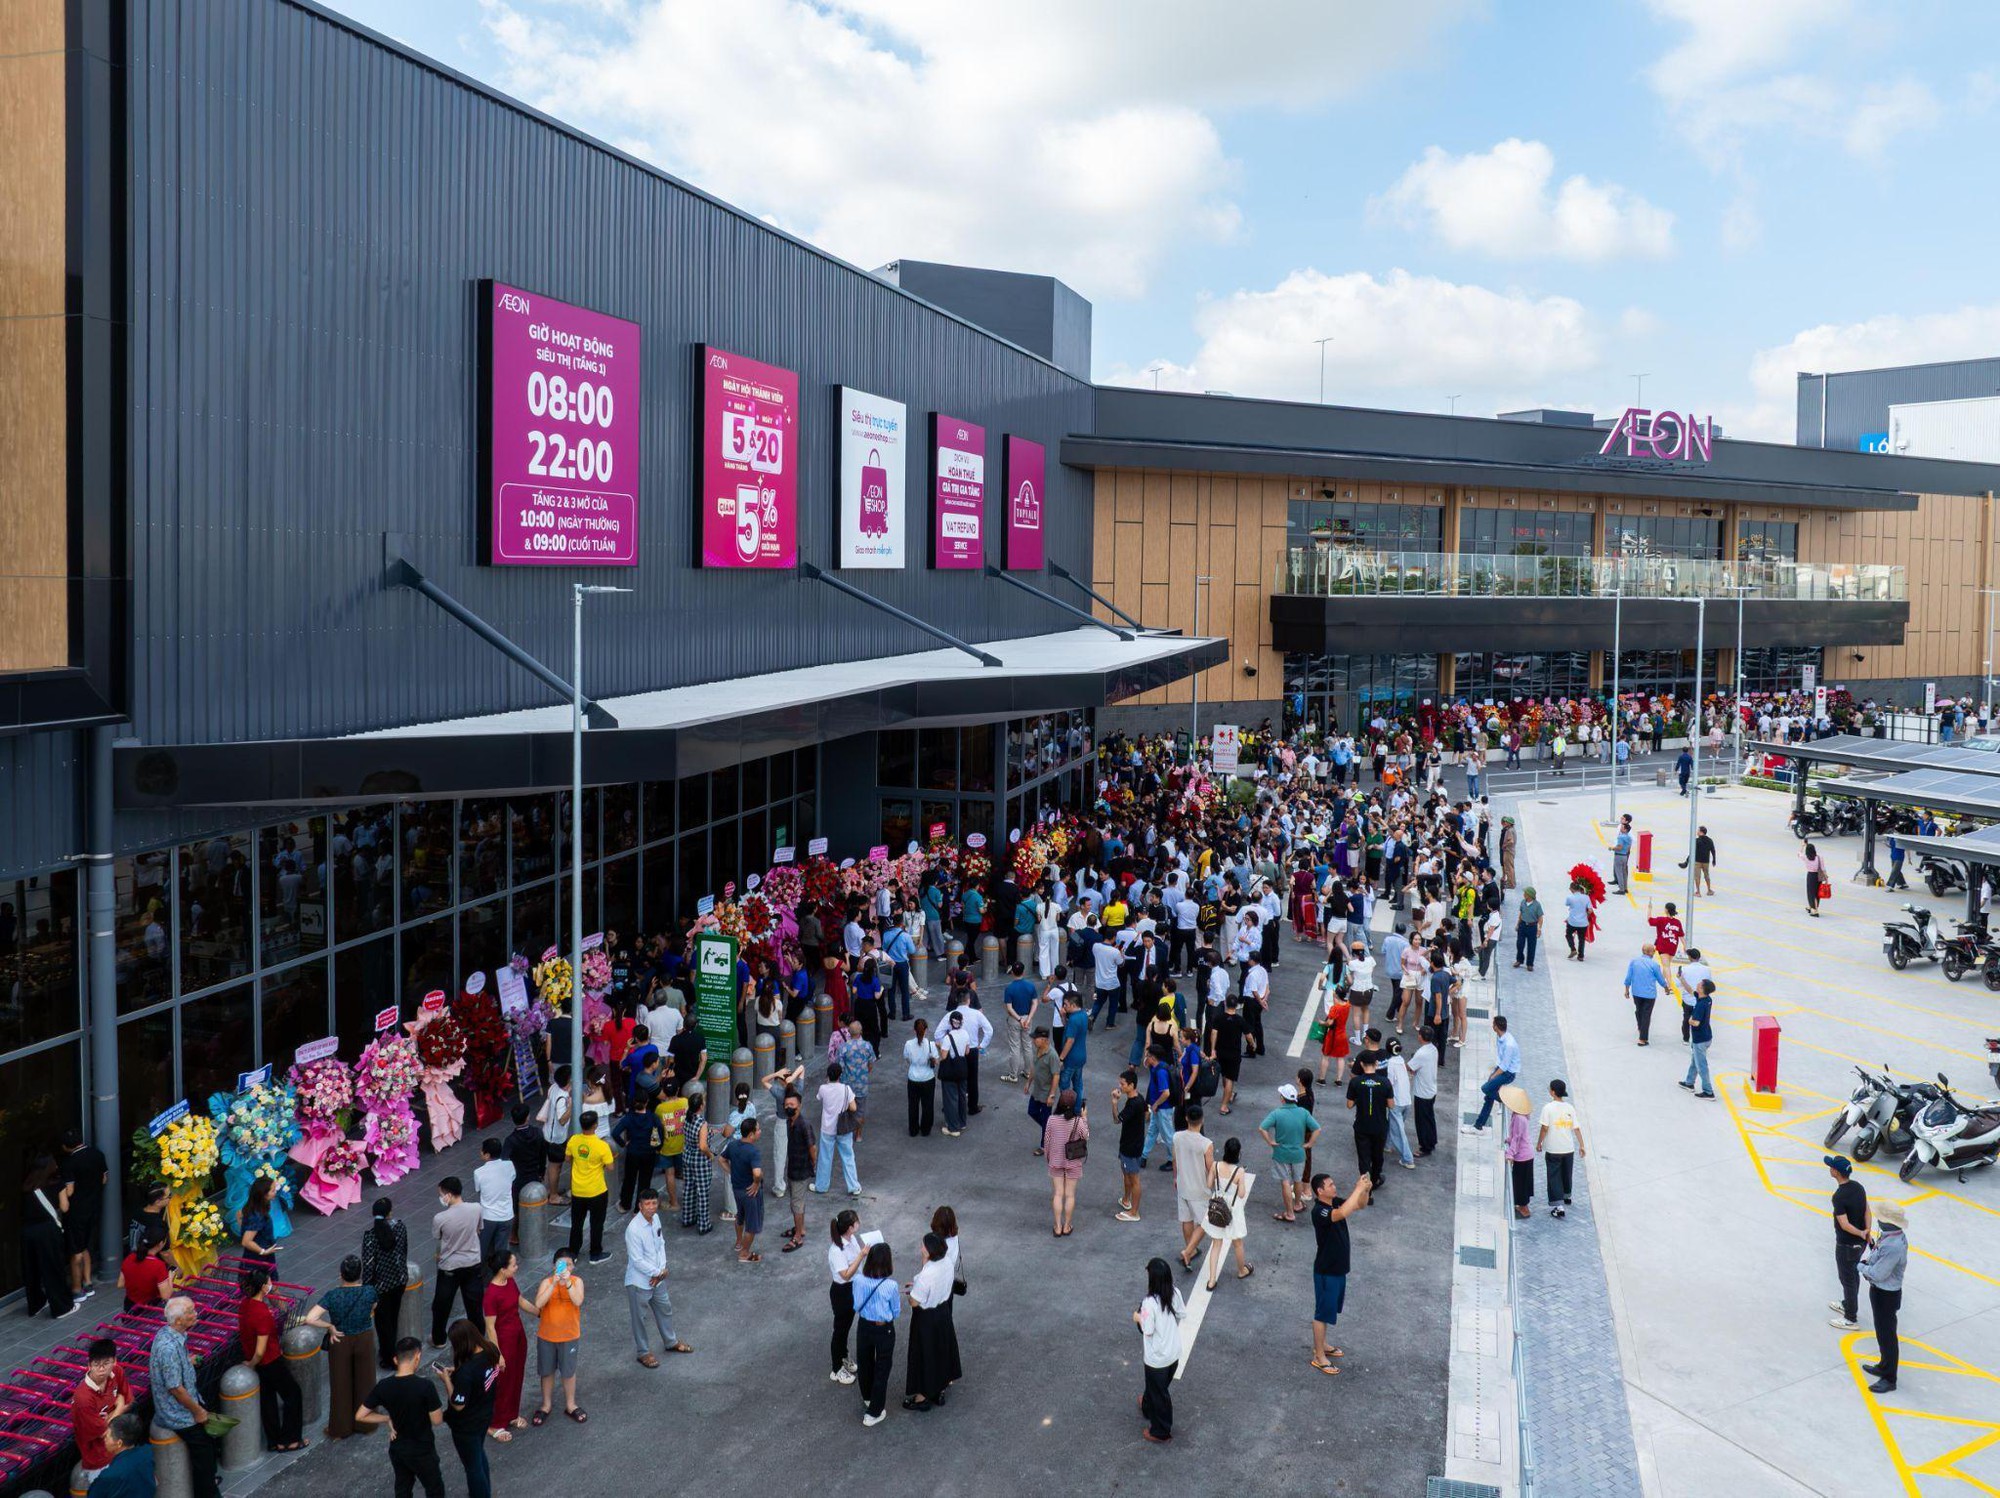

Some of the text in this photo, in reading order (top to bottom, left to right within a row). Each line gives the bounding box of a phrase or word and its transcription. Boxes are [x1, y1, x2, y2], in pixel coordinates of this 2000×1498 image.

[529, 322, 614, 358] GIỜ HOẠT ĐỘNG
[536, 347, 556, 363] SIÊU
[556, 352, 571, 370] THỊ
[599, 363, 606, 377] 1)
[723, 379, 740, 393] NGÀY
[528, 371, 613, 428] 08:00
[852, 409, 864, 423] Siêu
[732, 417, 779, 464] 5 & 20
[528, 430, 613, 483] 22:00
[557, 496, 562, 507] 2
[563, 497, 569, 508] &
[571, 497, 576, 508] 3
[591, 495, 608, 511] CỬA
[520, 509, 620, 533] 10:00 (NGÀY THƯỜNG)
[957, 521, 977, 534] REFUND
[524, 538, 531, 550] &
[533, 533, 567, 551] 09:00
[568, 535, 591, 553] (CUỐI
